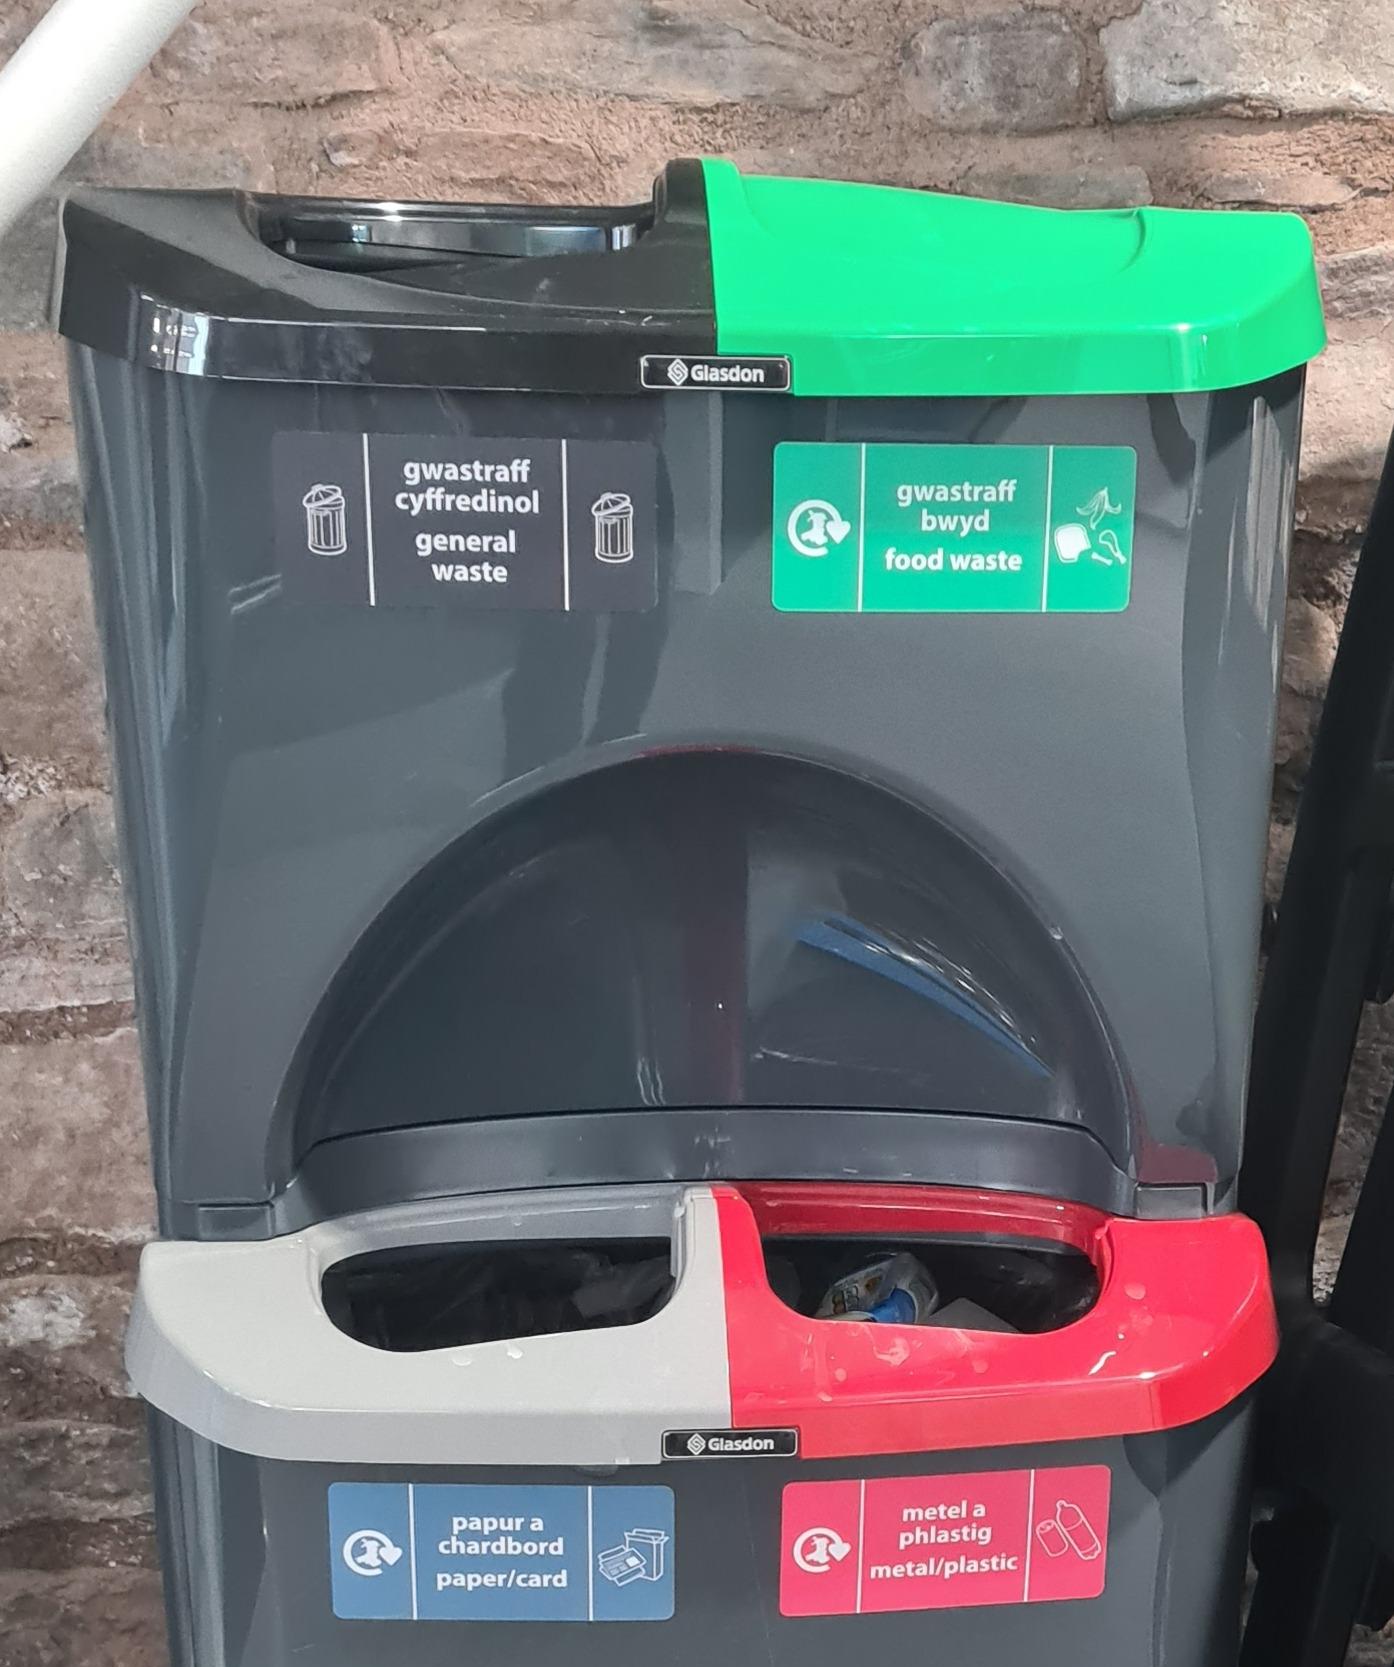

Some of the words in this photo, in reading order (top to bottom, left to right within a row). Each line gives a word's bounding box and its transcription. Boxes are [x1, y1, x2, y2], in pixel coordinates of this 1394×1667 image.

[690, 364, 765, 383] Glasdon
[403, 458, 531, 485] gwastraff
[395, 489, 539, 515] cyffredinol
[896, 479, 1017, 507] gwastraff
[921, 509, 990, 538] bwyd
[415, 529, 516, 557] general
[431, 561, 508, 583] waste
[884, 547, 944, 571] food
[949, 550, 1023, 572] waste
[707, 1436, 775, 1451] Glasdon
[902, 1500, 967, 1521] metel
[972, 1503, 986, 1518] a
[452, 1516, 525, 1536] papur
[529, 1517, 544, 1532] a
[899, 1523, 992, 1550] phlastig
[438, 1537, 564, 1555] chardbord
[870, 1553, 1018, 1579] metal/plastic
[436, 1569, 568, 1591] paper/card
